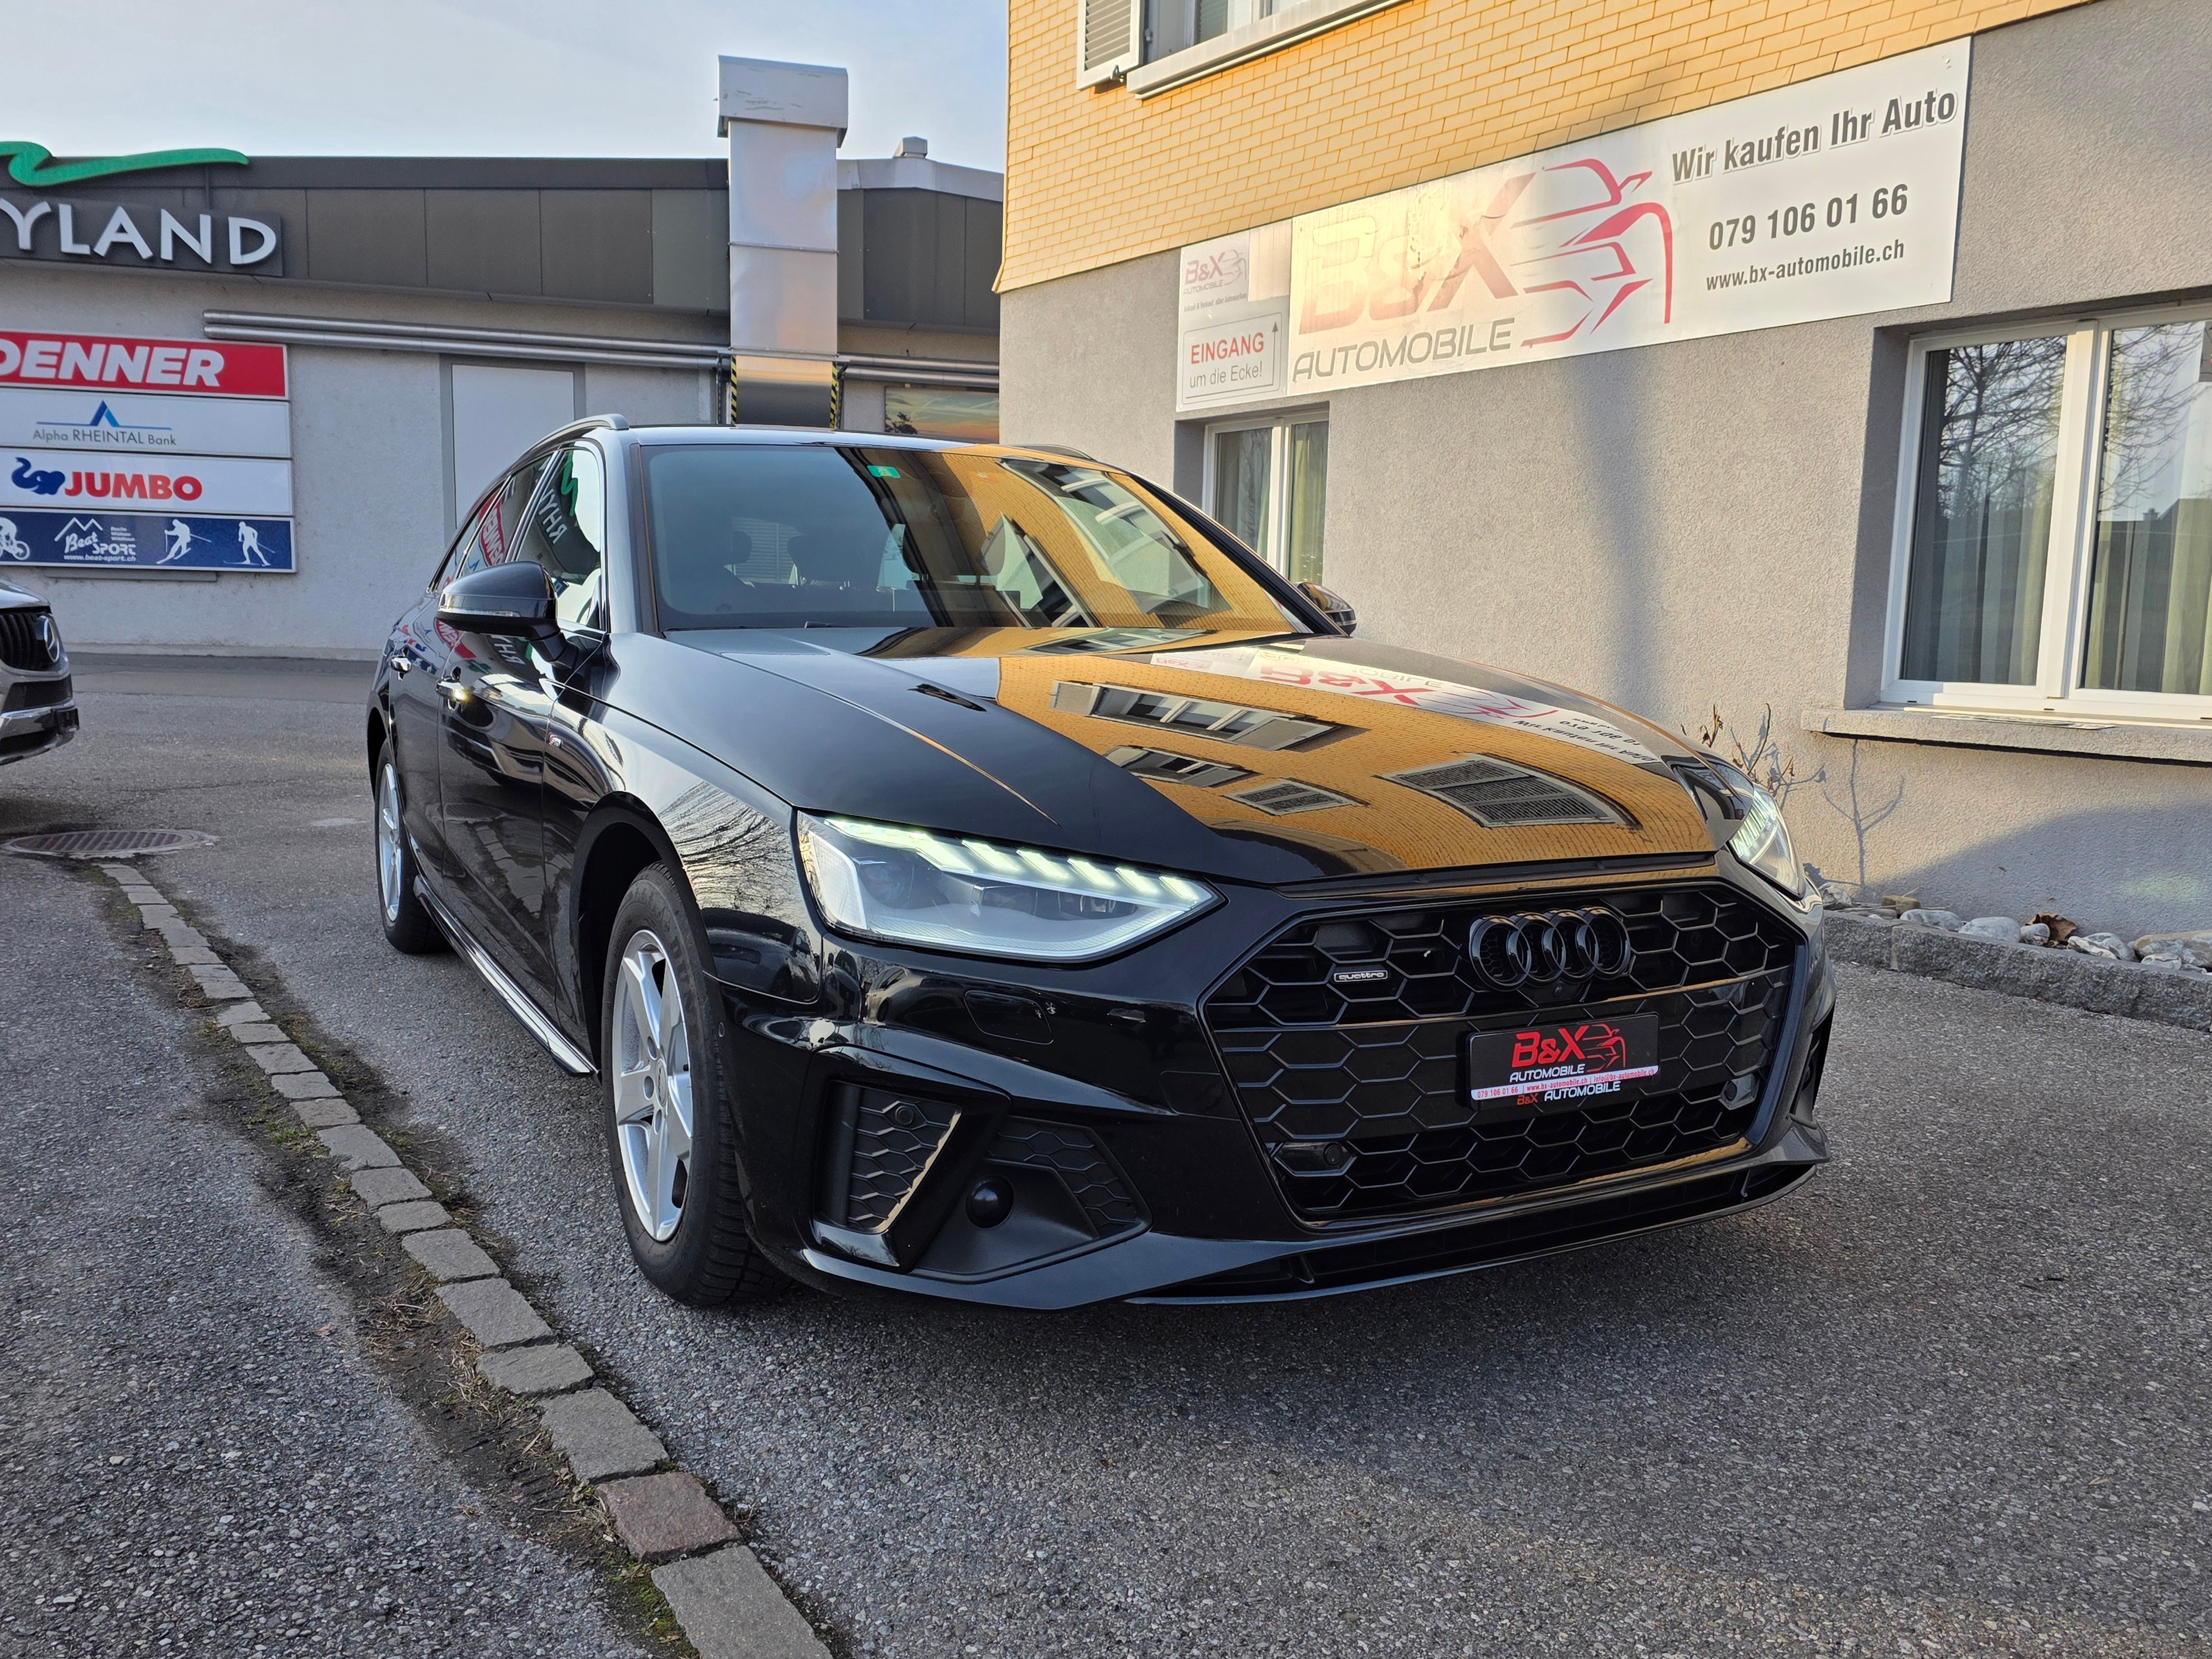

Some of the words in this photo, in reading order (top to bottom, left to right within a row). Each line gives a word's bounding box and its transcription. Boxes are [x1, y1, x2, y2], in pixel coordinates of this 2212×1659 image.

[1672, 147, 1714, 181] Wir
[1724, 126, 1819, 170] kaufen
[1832, 110, 1872, 145] Ihr
[1881, 91, 1955, 134] Auto
[0, 198, 276, 264] YLAND
[1709, 215, 1756, 250] 079
[1767, 203, 1815, 239] 106
[1827, 193, 1858, 227] 01
[1872, 184, 1908, 219] 66
[1298, 171, 1536, 335] B&X
[1706, 239, 1905, 290] www.bx-automobile.ch
[1185, 252, 1225, 285] B&X
[1183, 279, 1224, 295] AUTOMOBILE
[1191, 332, 1264, 364] EINGANG
[1292, 317, 1515, 382] AUTOMOBILE
[1190, 374, 1206, 388] um
[1210, 368, 1226, 384] die
[1230, 361, 1262, 382] Ecke!
[33, 429, 69, 442] Alpha
[72, 430, 144, 444] RHEINTAL
[148, 434, 176, 446] Bank
[64, 471, 202, 501] JUMBO
[64, 531, 98, 554] Beat
[92, 543, 136, 555] SPORT
[1339, 972, 1384, 981] quattro
[1511, 1025, 1590, 1068] B&X
[1509, 1063, 1585, 1083] AUTOMOBILE
[1527, 1077, 1588, 1092] www.bx-automobile.ch
[1594, 1068, 1654, 1082] info@bx-automobile.ch
[1516, 1093, 1538, 1105] B&X
[1544, 1081, 1621, 1101] AUTOMOBILE
